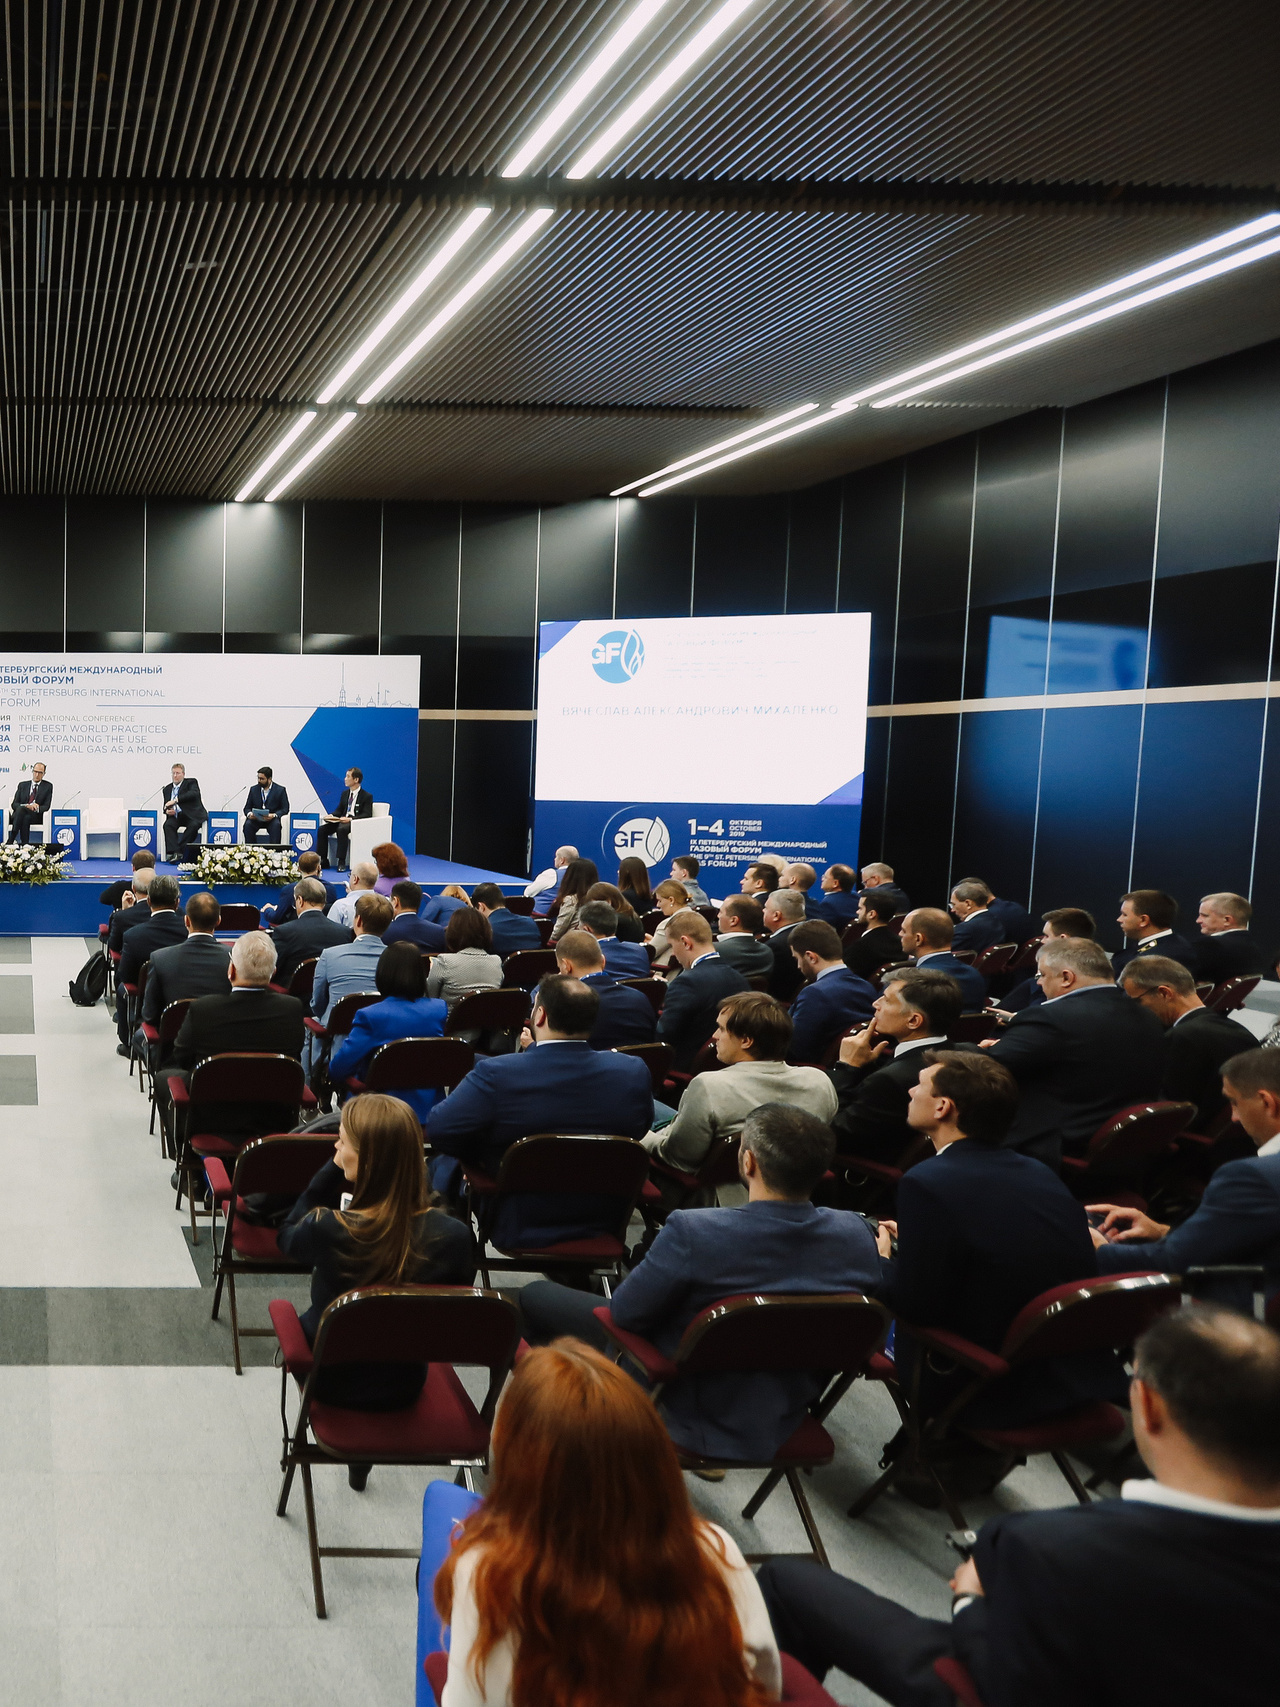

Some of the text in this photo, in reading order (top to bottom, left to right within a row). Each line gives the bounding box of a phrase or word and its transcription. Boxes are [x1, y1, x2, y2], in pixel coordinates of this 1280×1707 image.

[70, 665, 162, 674] МЕЖДУНАРОДНЫЙ
[32, 676, 74, 684] ФОРУМ
[26, 689, 87, 697] PETERSBURG
[1, 699, 40, 707] FORUM
[70, 725, 108, 733] WORLD
[112, 725, 167, 733] PRACTICES
[43, 735, 102, 743] EXPANDING
[105, 735, 125, 743] THE
[19, 745, 32, 753] OF
[36, 745, 84, 753] NATURAL
[137, 746, 173, 754] MOTOR
[177, 746, 202, 754] FUEL
[698, 839, 757, 847] ПЕТЕРБУРГСКИЙ
[758, 841, 827, 849] МЕЖДУНАРОДНЫЙ
[690, 845, 762, 854] ГАЗОВЫЙ ФОРУМ
[708, 860, 738, 868] FORUM
